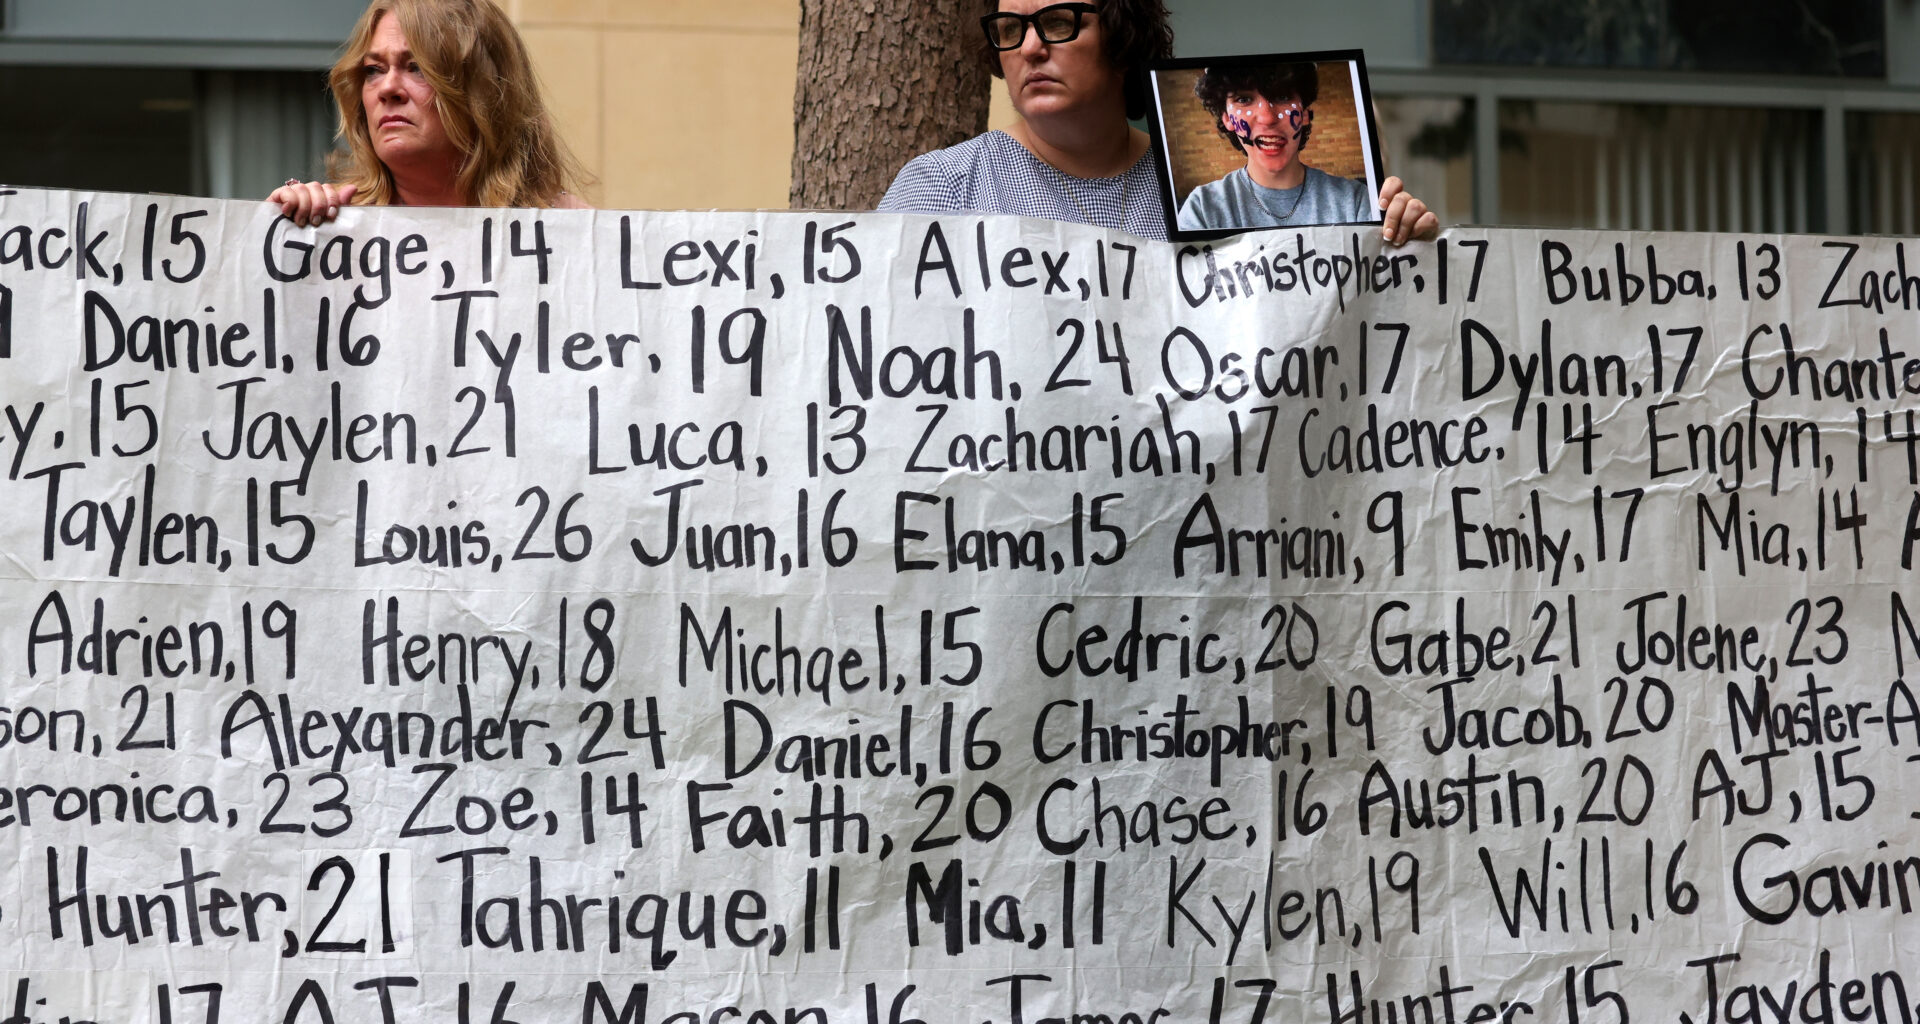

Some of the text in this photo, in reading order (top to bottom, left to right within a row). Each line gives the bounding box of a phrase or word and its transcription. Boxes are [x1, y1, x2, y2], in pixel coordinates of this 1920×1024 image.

[0, 190, 123, 286] ack,
[143, 203, 208, 283] 15
[481, 218, 552, 284] 14
[803, 221, 861, 284] 15
[1097, 240, 1136, 299] 17
[1437, 238, 1488, 305] 17
[1737, 241, 1780, 300] 13
[316, 297, 381, 371] 16
[691, 305, 767, 396] 19
[1044, 319, 1133, 396] 24
[1358, 320, 1410, 396] 17
[1648, 324, 1703, 394] 17
[91, 378, 158, 457] 15
[447, 386, 516, 458] 21
[807, 402, 867, 478] 13
[1228, 405, 1278, 476] 17
[1537, 402, 1602, 475] 14
[1856, 407, 1920, 485] 14
[247, 478, 317, 567] 15
[512, 485, 593, 561] 26
[797, 488, 858, 568] 16
[1072, 491, 1126, 568] 15
[1367, 491, 1403, 576] 9
[1593, 485, 1644, 562] 17
[1818, 483, 1867, 571] 14
[243, 600, 297, 685] 19
[558, 597, 617, 691] 18
[920, 606, 981, 686] 15
[1254, 601, 1318, 671] 20
[1531, 594, 1579, 669] 21
[1786, 596, 1849, 668] 23
[116, 684, 175, 751] 21
[577, 697, 667, 770] 24
[939, 701, 1001, 775] 16
[1326, 685, 1375, 758] 19
[1604, 676, 1674, 742] 20
[260, 772, 352, 838] 23
[580, 771, 647, 848] 14
[910, 781, 1012, 853] 20
[1277, 769, 1328, 841] 16
[1577, 754, 1654, 827] 20
[1815, 745, 1875, 822] 15
[305, 852, 396, 954] 21
[803, 865, 841, 954] 11
[1062, 860, 1106, 949] 11
[1368, 851, 1420, 943] 19
[1645, 837, 1700, 922] 16
